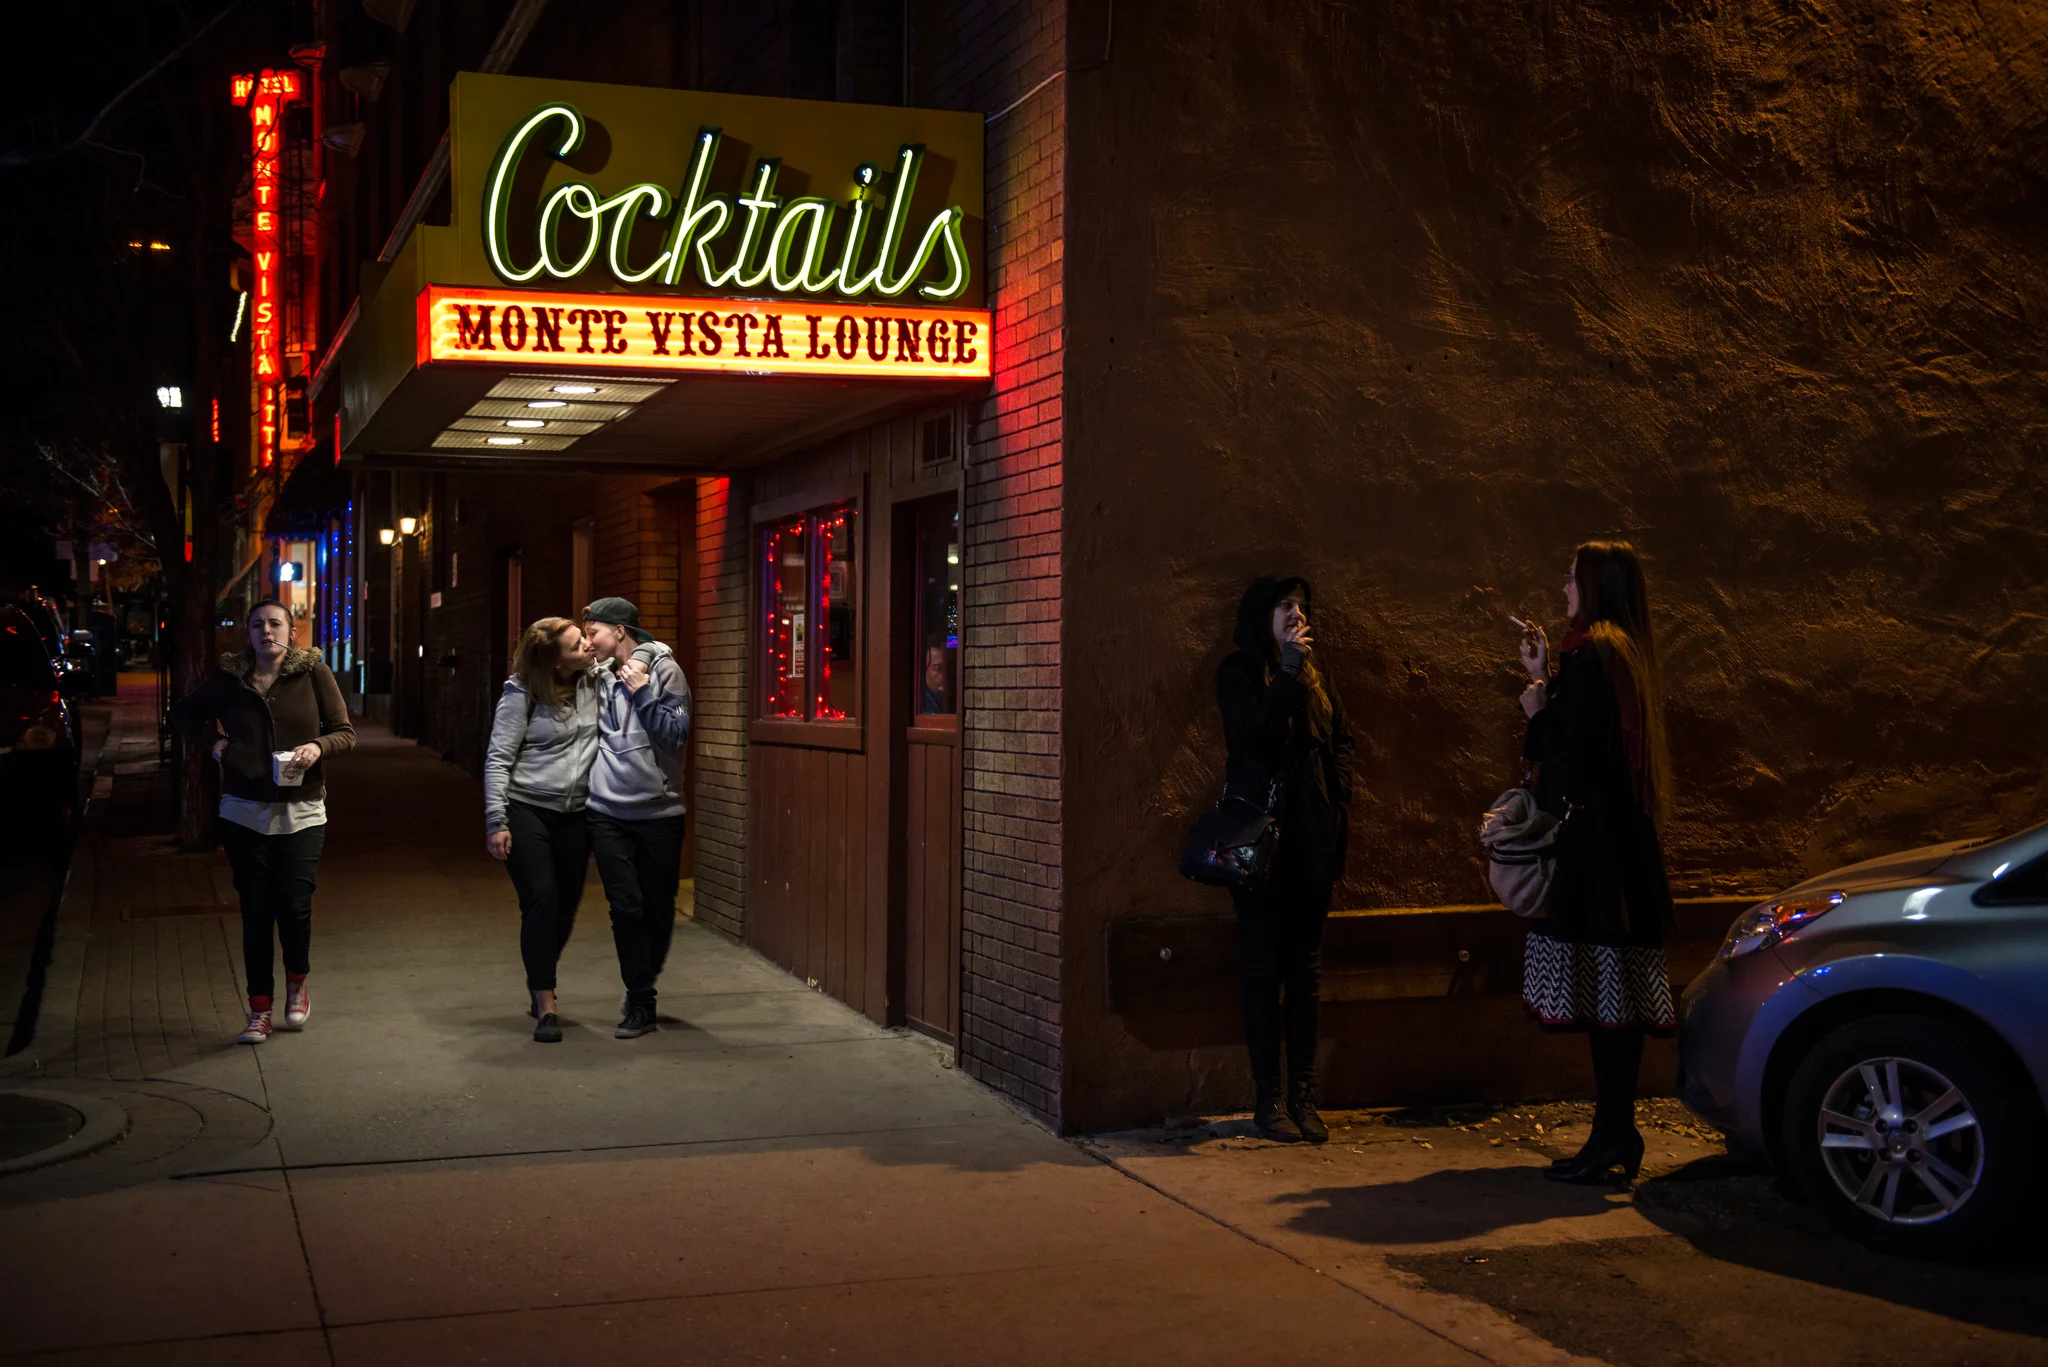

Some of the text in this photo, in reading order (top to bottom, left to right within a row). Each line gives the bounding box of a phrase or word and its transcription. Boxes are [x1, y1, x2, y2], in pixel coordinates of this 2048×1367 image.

[255, 104, 273, 374] MONTE VISTA
[484, 101, 970, 300] Cocktails
[453, 304, 979, 364] MONTE VISTA LOUNGE
